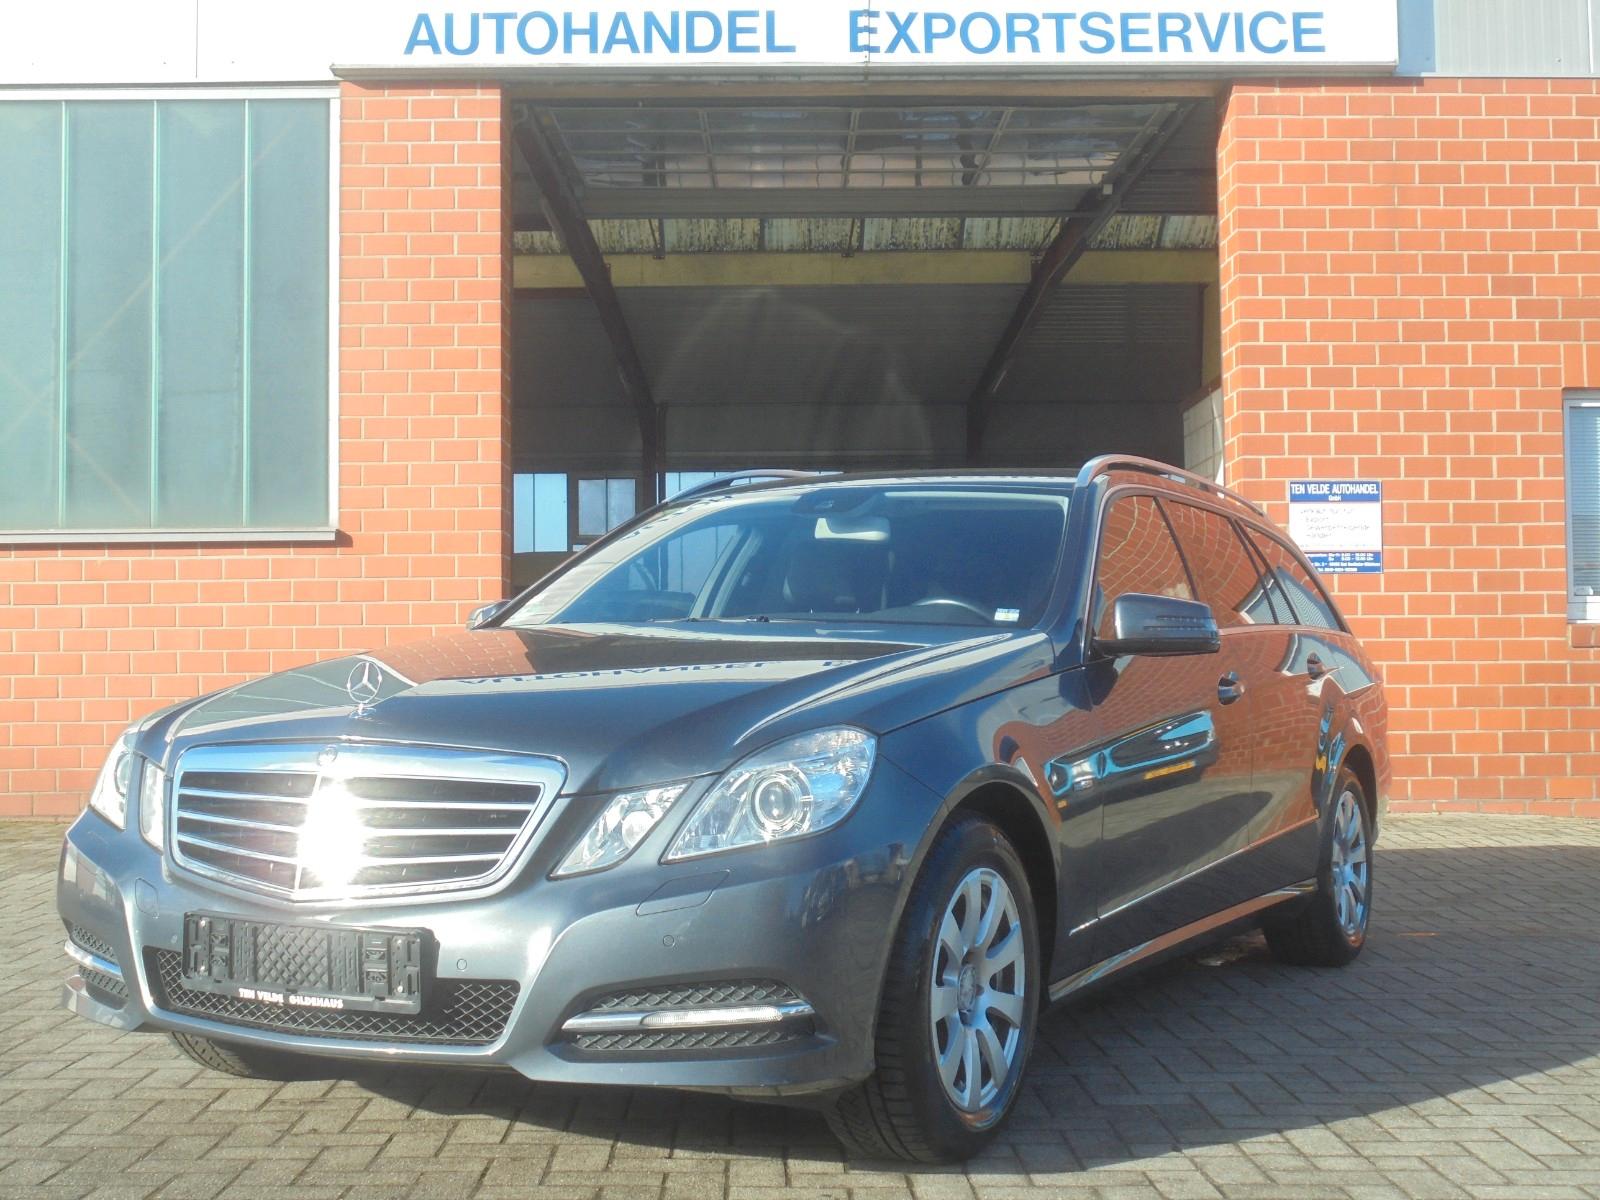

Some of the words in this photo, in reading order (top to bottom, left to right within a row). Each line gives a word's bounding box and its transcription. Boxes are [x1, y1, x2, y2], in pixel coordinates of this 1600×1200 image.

[404, 10, 796, 55] AUTOHANDEL
[848, 10, 1326, 54] EXPORTSERVICE
[1291, 484, 1305, 494] TEN
[1307, 484, 1330, 494] VELDE
[1332, 484, 1378, 494] AUTOHANDEL
[239, 988, 255, 999] TEN
[256, 990, 285, 1003] VELDE
[289, 995, 344, 1009] GILDEHAUS
